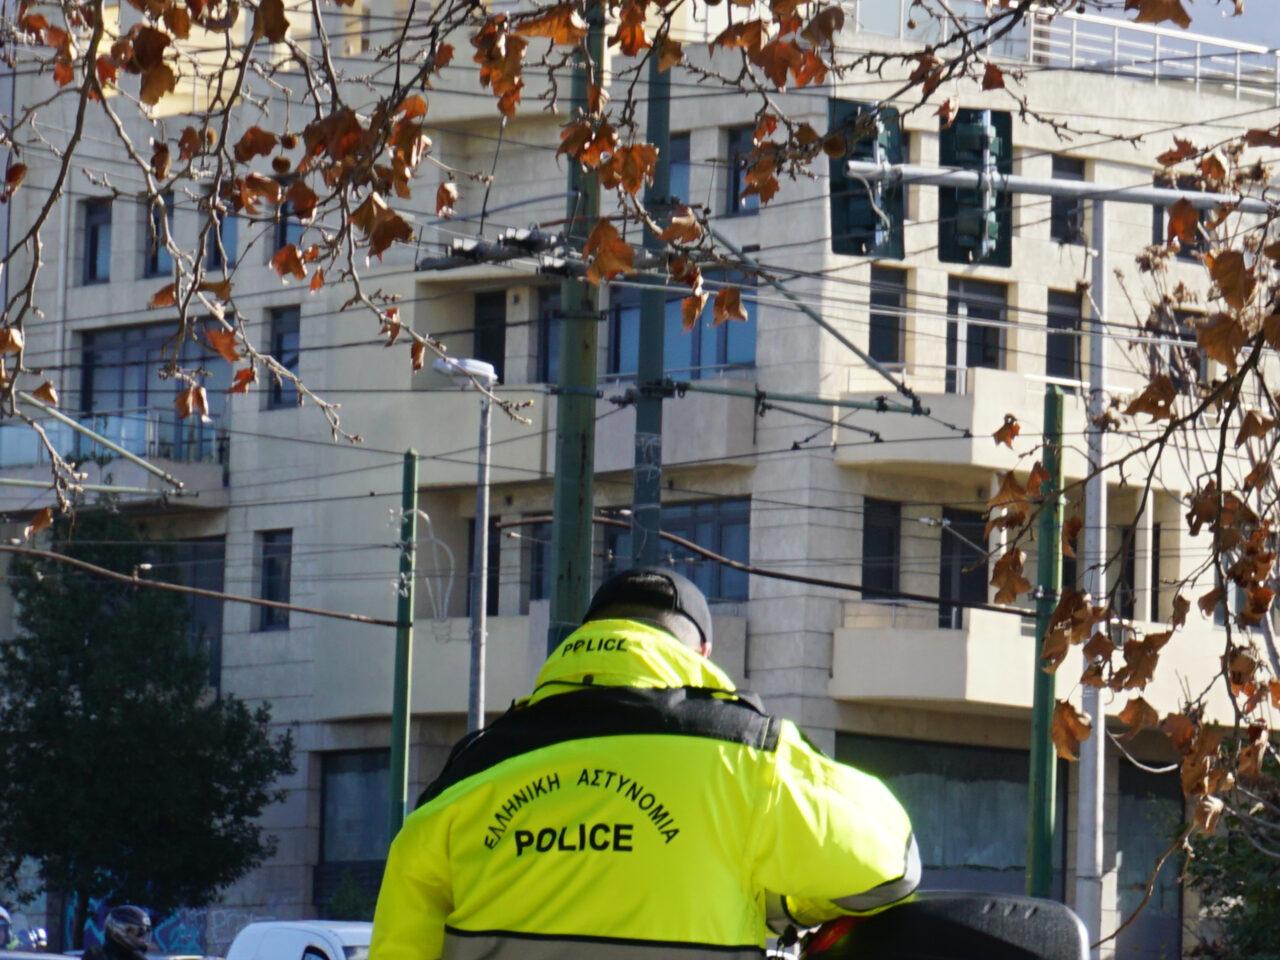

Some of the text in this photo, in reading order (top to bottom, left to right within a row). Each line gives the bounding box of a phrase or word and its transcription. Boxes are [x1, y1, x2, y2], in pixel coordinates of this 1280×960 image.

[561, 637, 628, 657] POLICE
[484, 768, 680, 850] ΕΛΛΗΝΙΚΗ ΑΣΤΥΝΟΜΙΑ
[514, 823, 634, 857] POLICE
